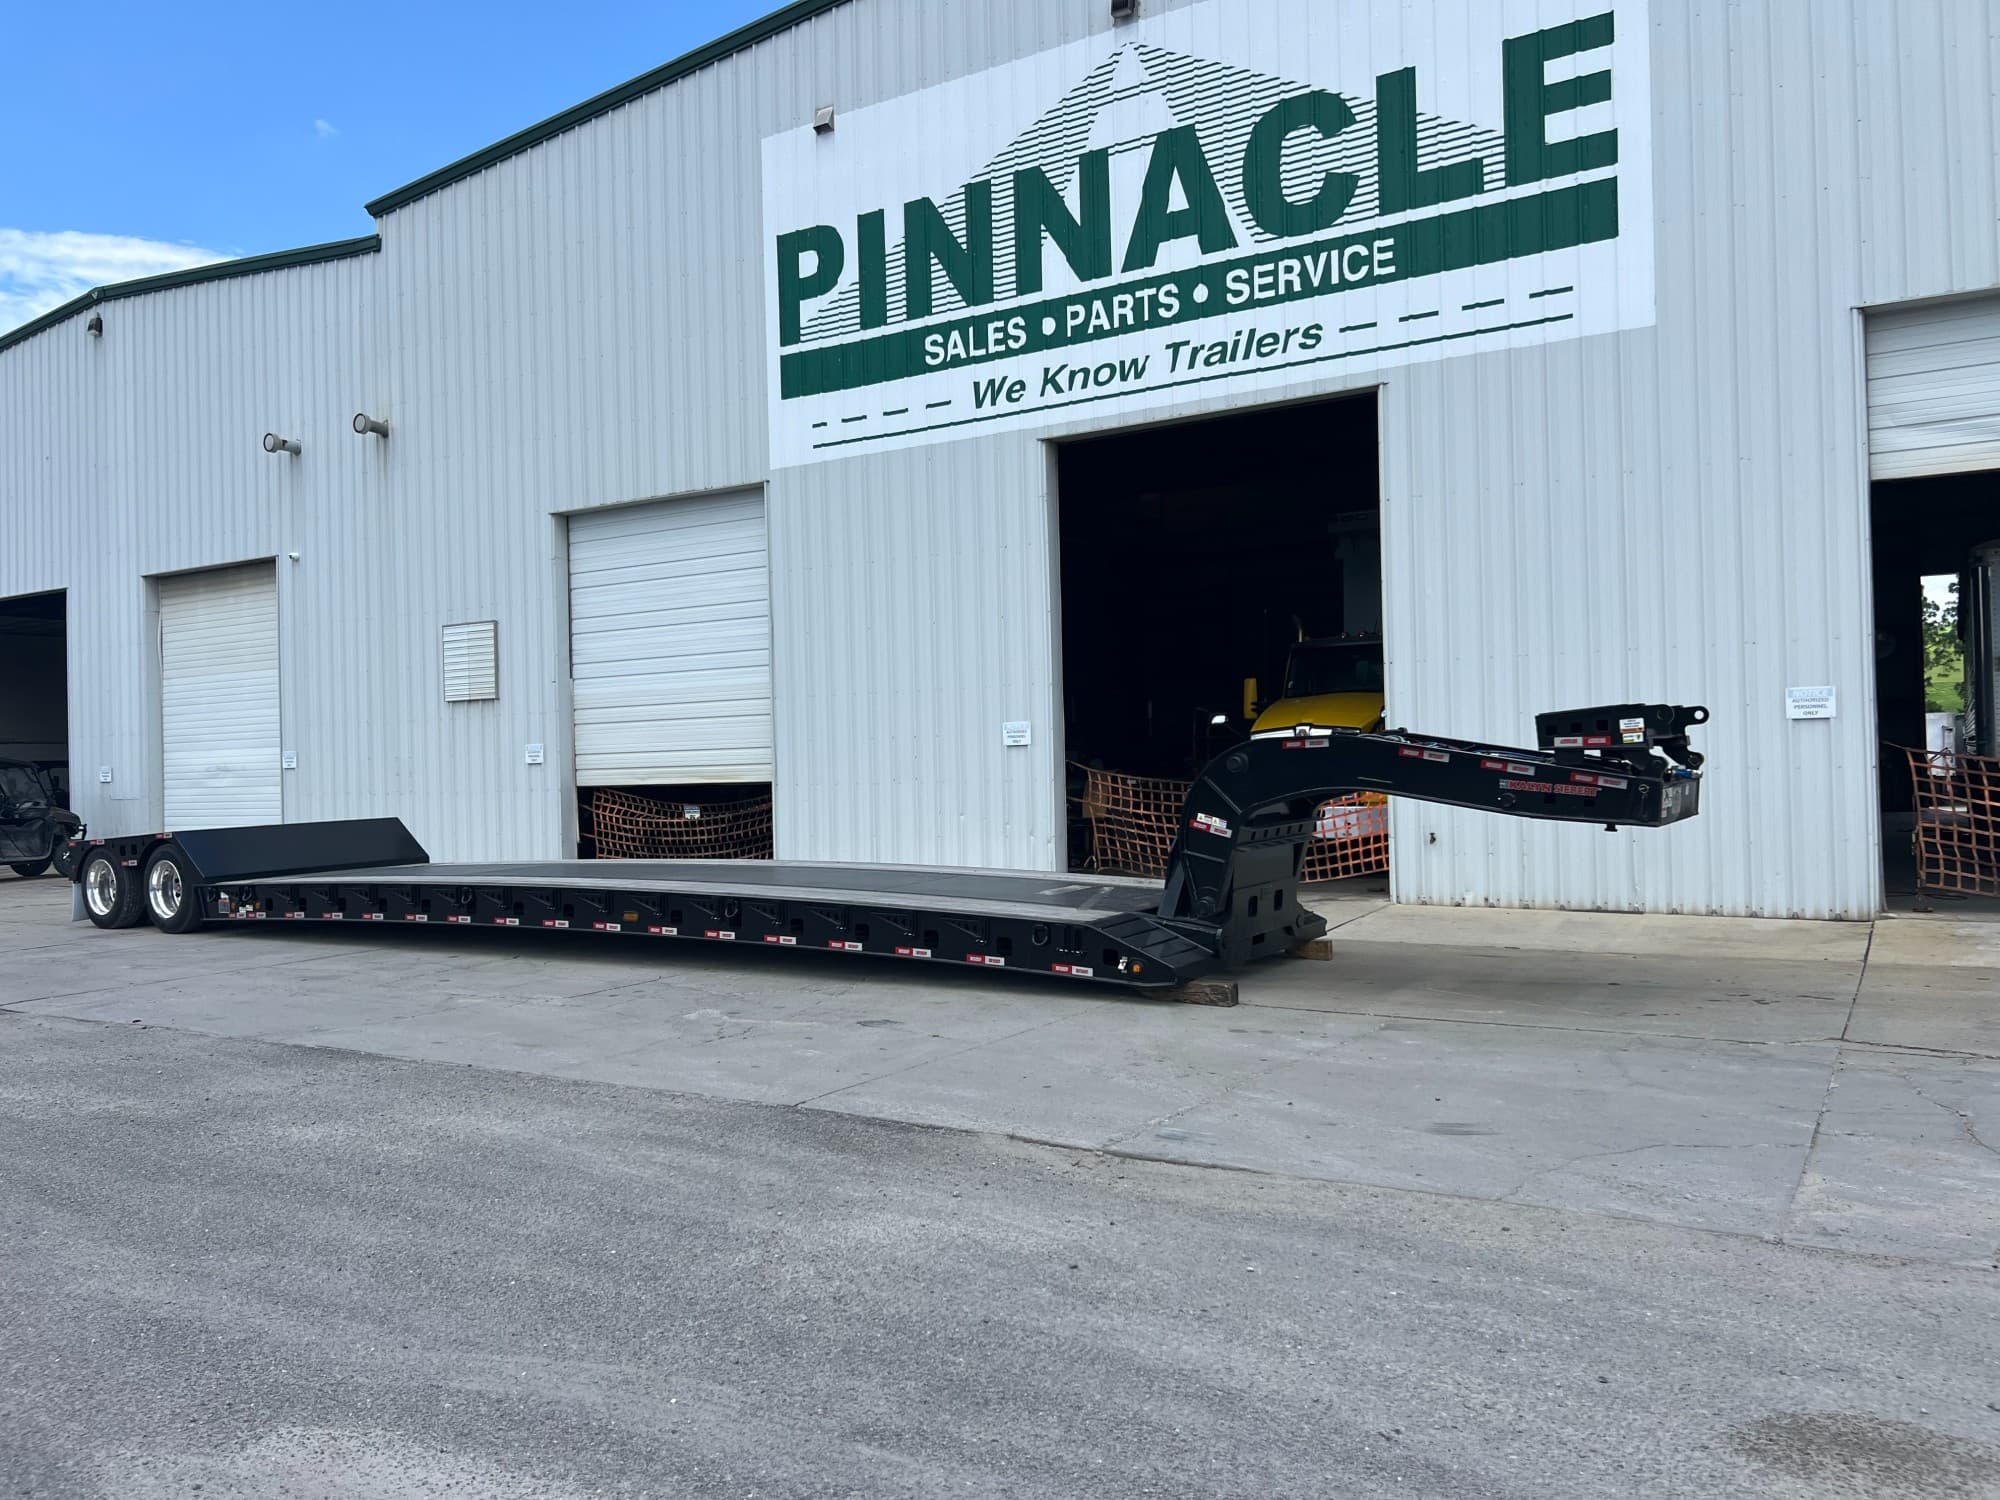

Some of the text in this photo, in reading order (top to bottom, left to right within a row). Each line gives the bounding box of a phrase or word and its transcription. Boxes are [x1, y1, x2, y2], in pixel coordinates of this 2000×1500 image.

[777, 10, 1618, 347] PINNACLE
[924, 238, 1396, 366] SALES PARTS SERVICE
[973, 323, 1323, 410] We Know Trailers
